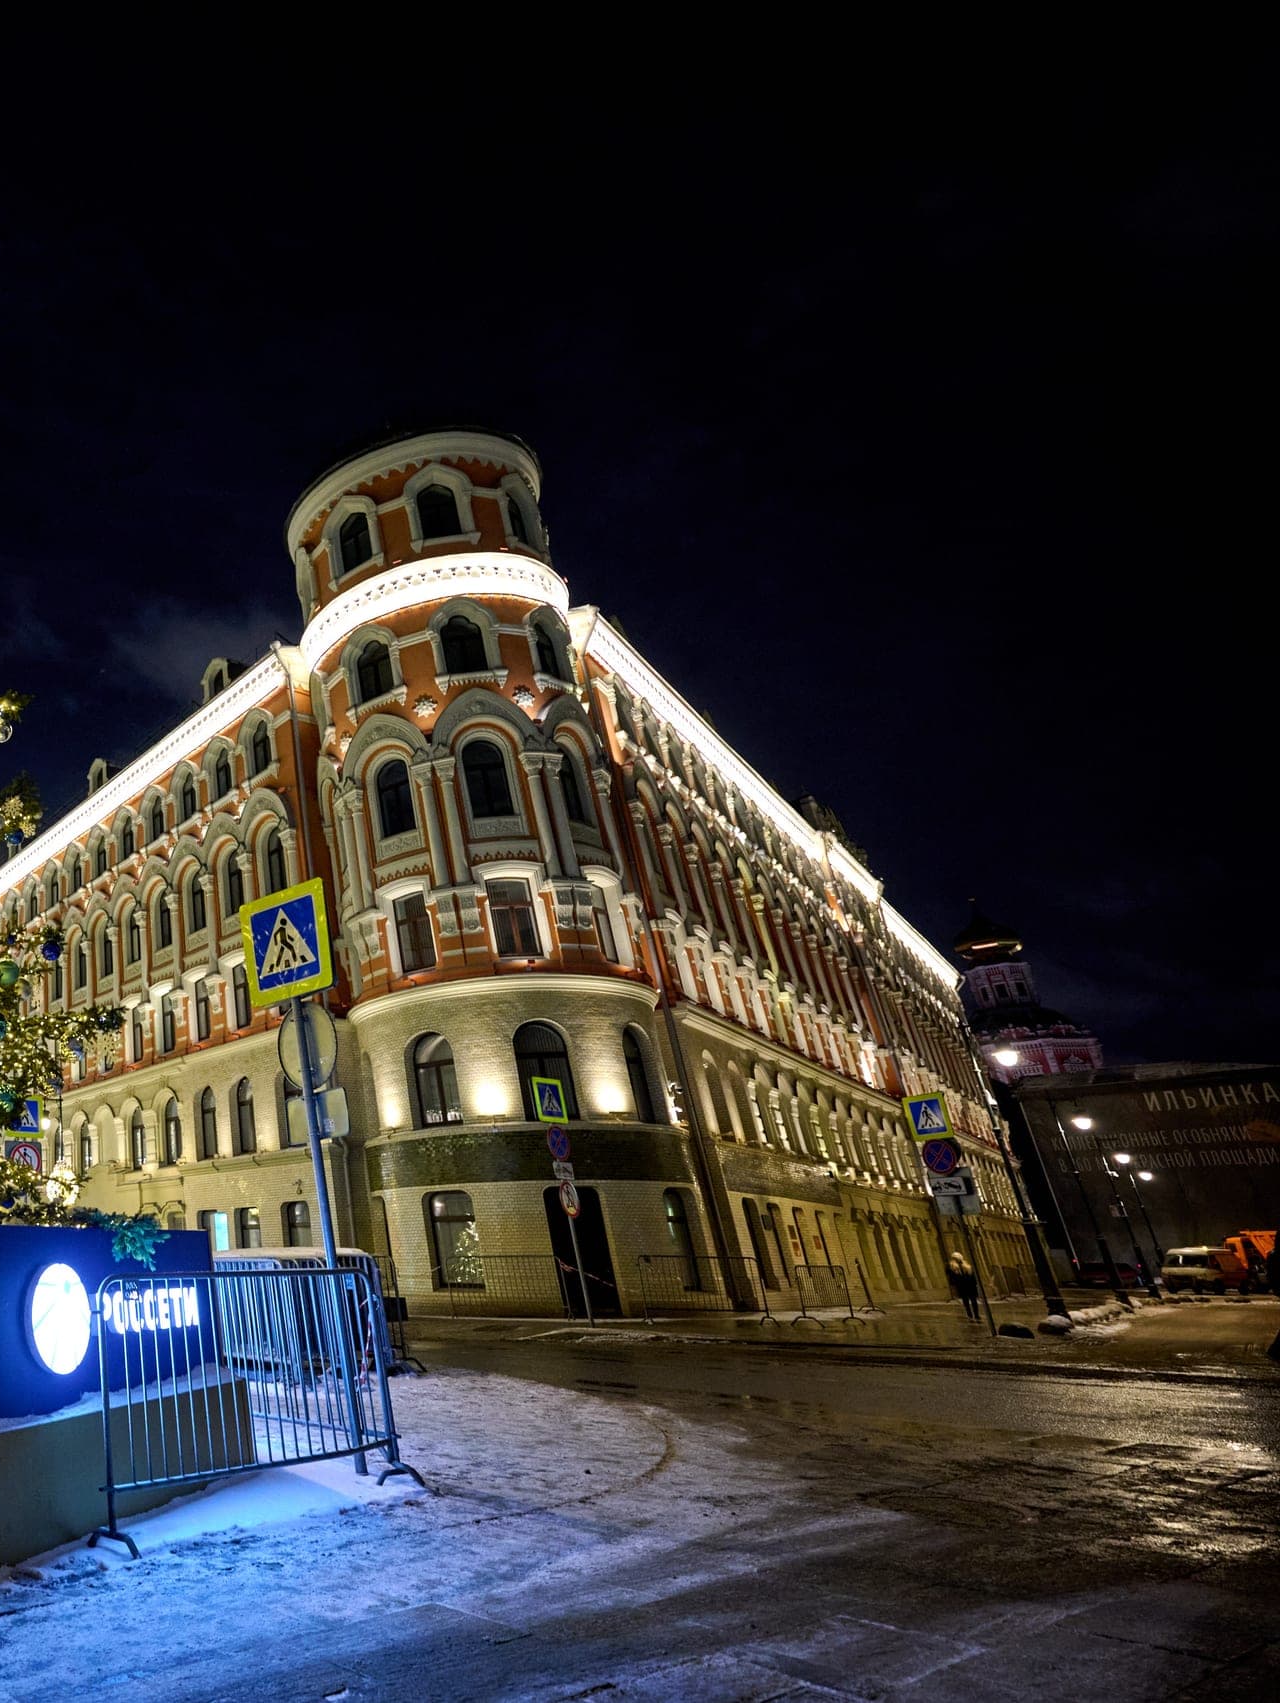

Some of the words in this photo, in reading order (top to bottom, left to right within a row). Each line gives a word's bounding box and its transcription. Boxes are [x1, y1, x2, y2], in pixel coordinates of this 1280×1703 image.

[1142, 1082, 1280, 1112] ИЛЬИНКА
[1172, 1125, 1253, 1145] ОСОБНЯКИ
[1132, 1146, 1197, 1169] РАСНОЙ
[1199, 1147, 1280, 1168] ПЛОЩАДИ
[97, 1286, 200, 1335] РОССЕТИ
